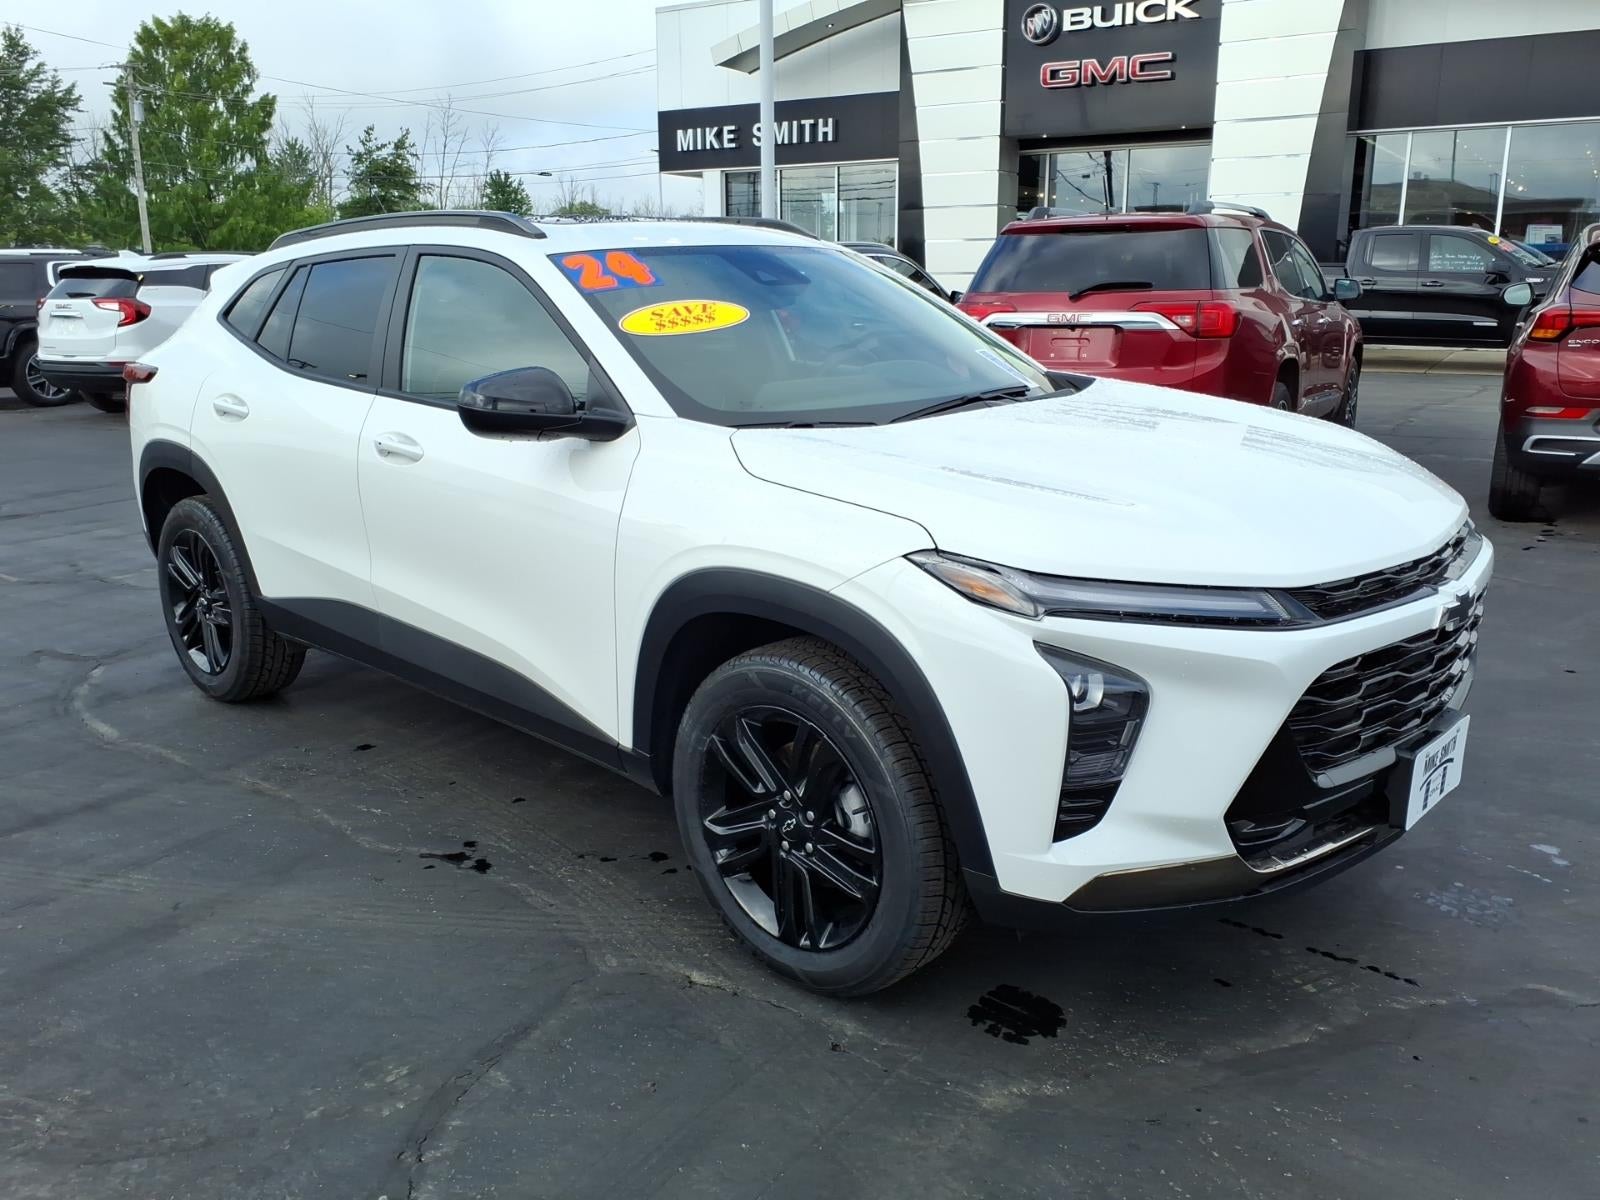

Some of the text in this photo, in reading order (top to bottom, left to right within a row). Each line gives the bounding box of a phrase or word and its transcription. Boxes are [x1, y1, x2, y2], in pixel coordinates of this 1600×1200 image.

[1062, 0, 1200, 32] BUICK
[1040, 52, 1173, 88] GMC
[676, 117, 834, 152] MIKE SMITH
[562, 251, 655, 291] 24
[650, 302, 716, 320] SAVE
[1047, 313, 1092, 324] GMC
[1423, 734, 1458, 777] MIKE SMITH
